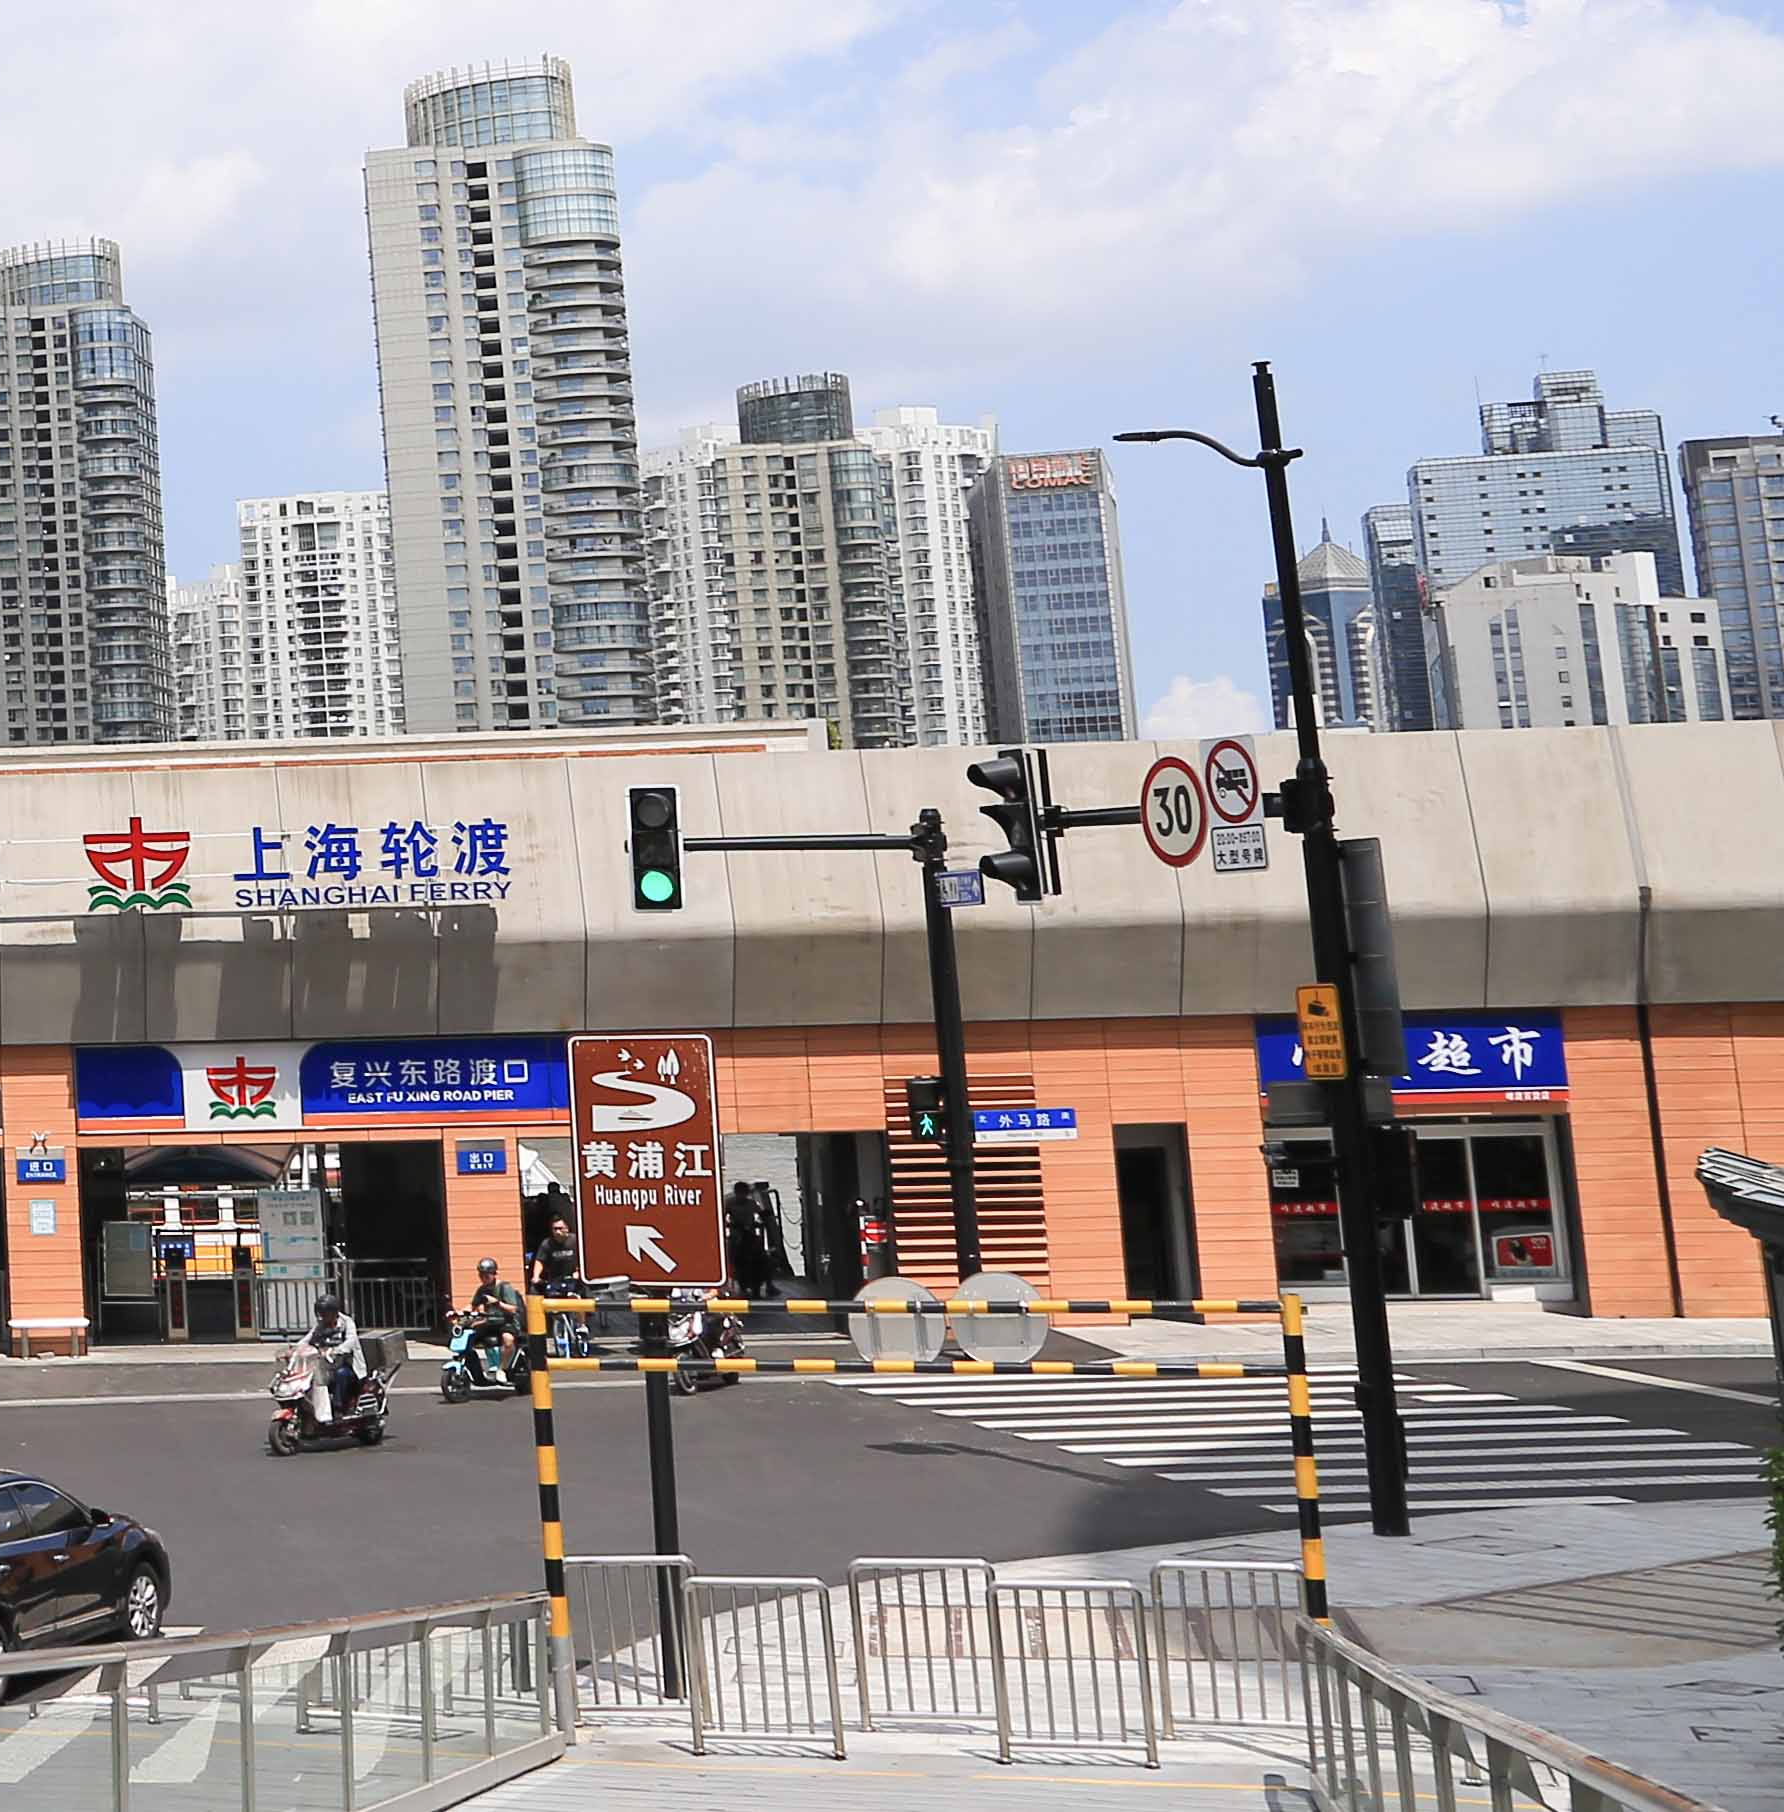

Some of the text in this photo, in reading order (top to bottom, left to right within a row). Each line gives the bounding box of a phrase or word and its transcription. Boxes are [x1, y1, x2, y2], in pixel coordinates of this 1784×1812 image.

[1012, 473, 1094, 489] COMAC
[1153, 785, 1192, 837] 30
[234, 818, 511, 880] 上海轮渡
[235, 881, 512, 907] SHANGHAI FERRY
[330, 1059, 529, 1088] 复兴东路渡口
[348, 1089, 514, 1104] EAST FU XING ROAD PIER
[998, 1113, 1050, 1128] 外马路
[469, 1153, 493, 1163] 出口
[581, 1141, 712, 1179] 黄浦江
[595, 1184, 702, 1211] Huangpu River
